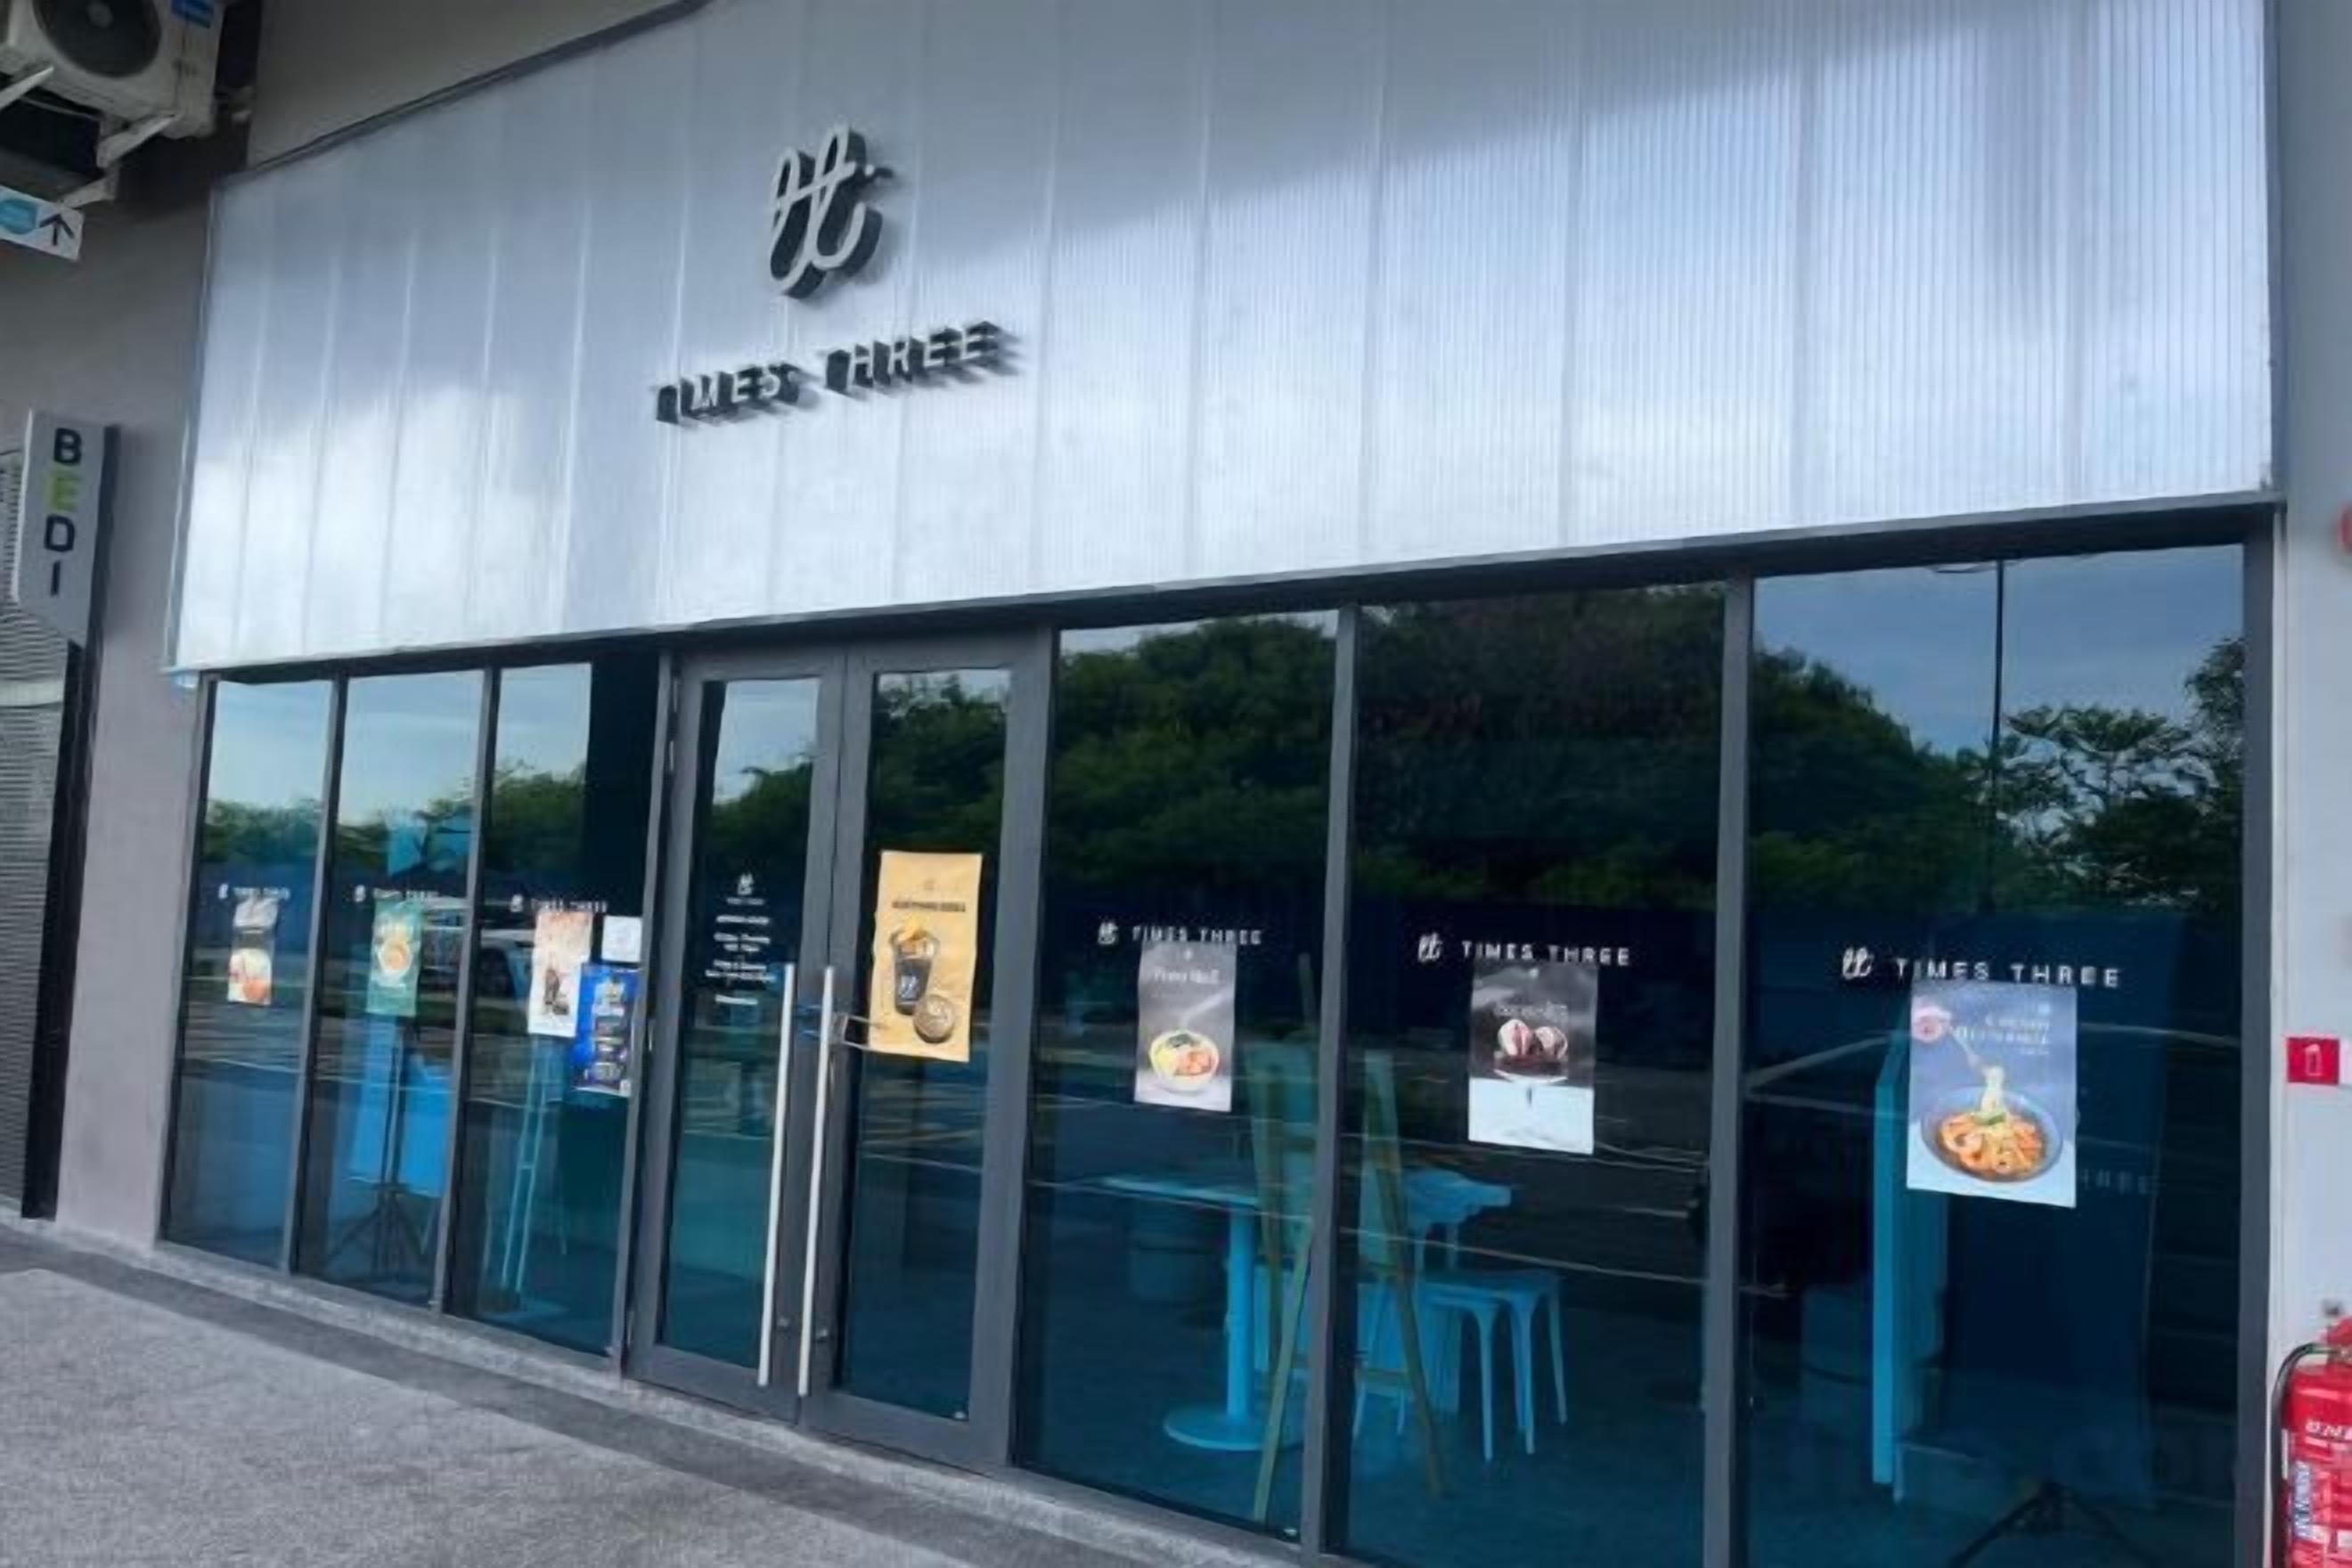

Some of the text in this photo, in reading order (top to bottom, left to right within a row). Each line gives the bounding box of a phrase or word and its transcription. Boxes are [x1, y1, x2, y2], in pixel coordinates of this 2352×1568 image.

[819, 321, 1003, 392] THREE
[45, 428, 82, 596] BEDI
[1462, 941, 1533, 960] TIMES
[1548, 945, 1629, 966] THREE
[1895, 958, 1989, 980] TIMES
[2011, 964, 2121, 987] THREE
